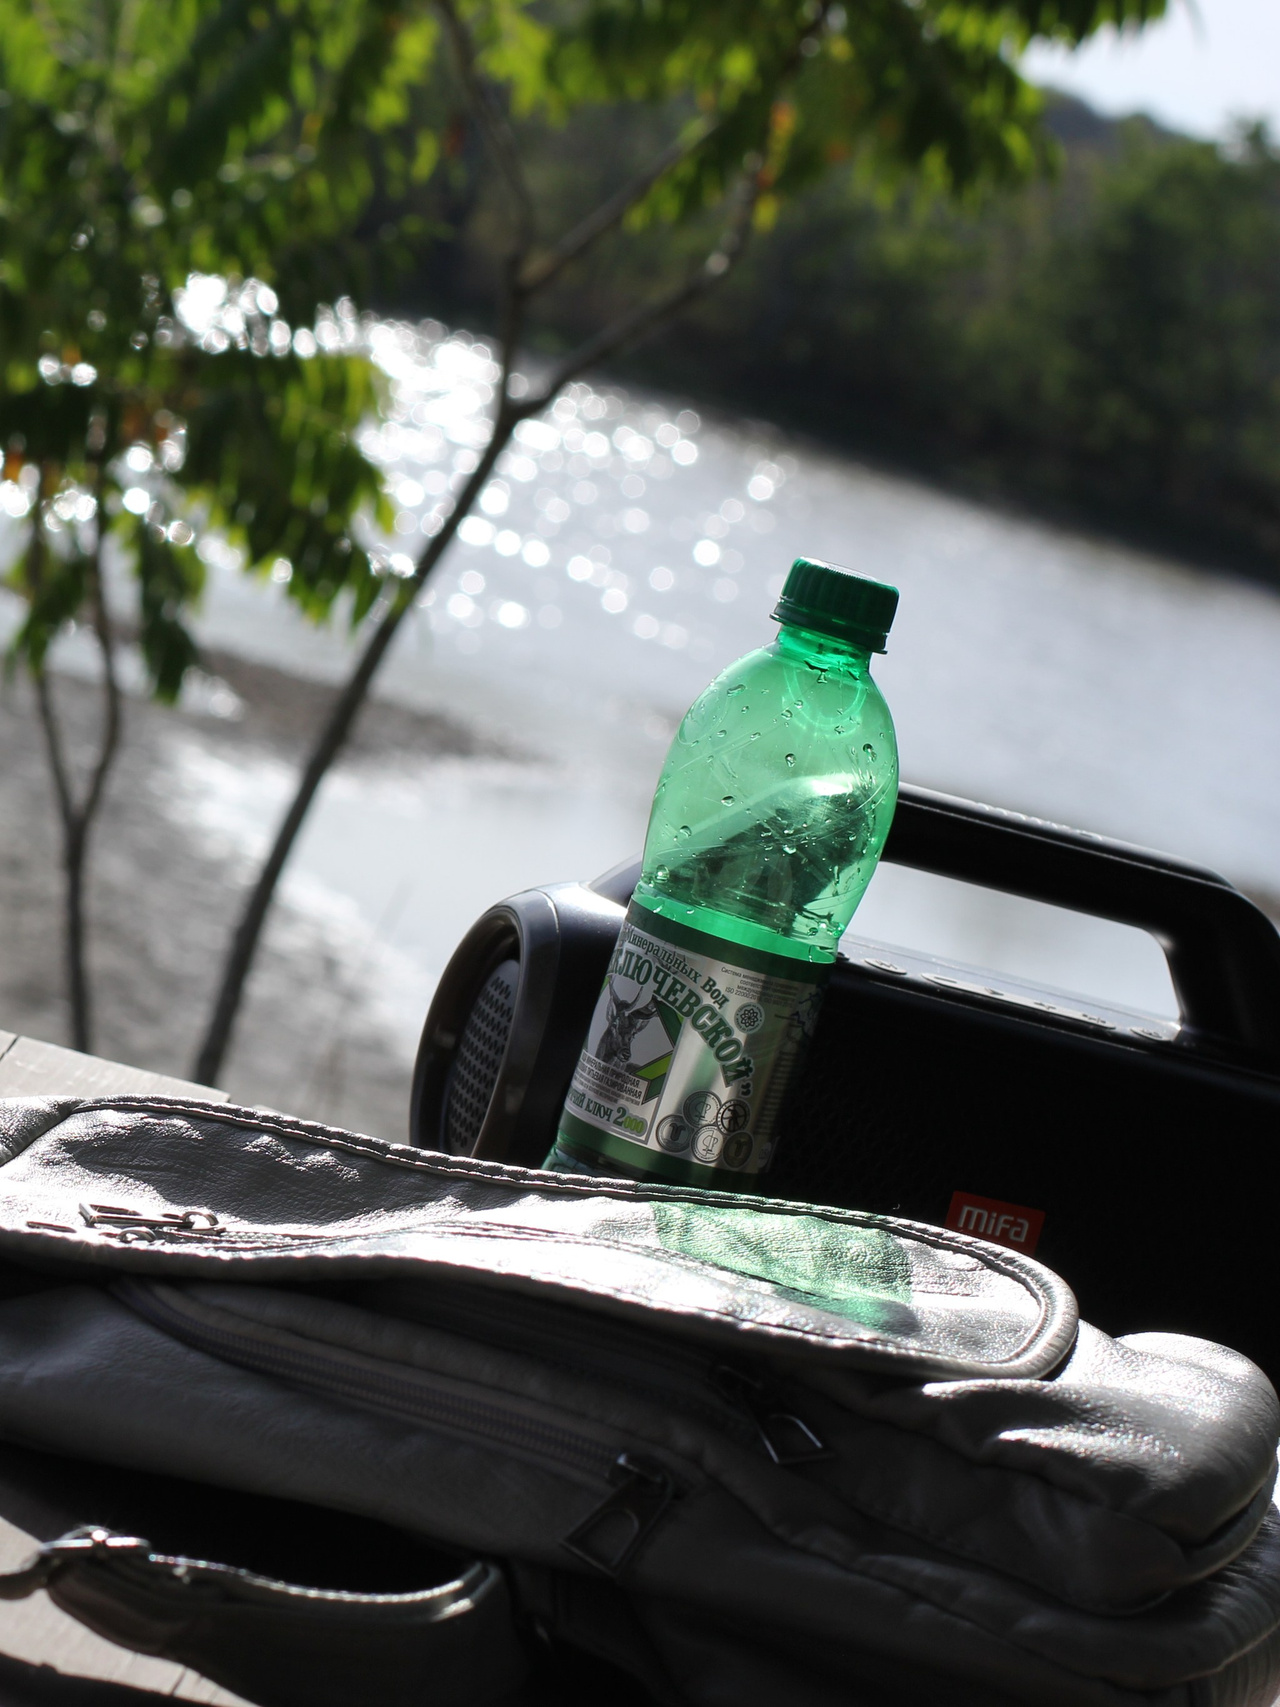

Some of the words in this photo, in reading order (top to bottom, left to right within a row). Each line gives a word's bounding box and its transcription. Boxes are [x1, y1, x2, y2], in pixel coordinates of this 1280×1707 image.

[701, 976, 729, 1009] Вод
[607, 948, 753, 1097] КЛЮЧЕВСКОЙ”
[584, 1098, 613, 1122] КЛЮЧ
